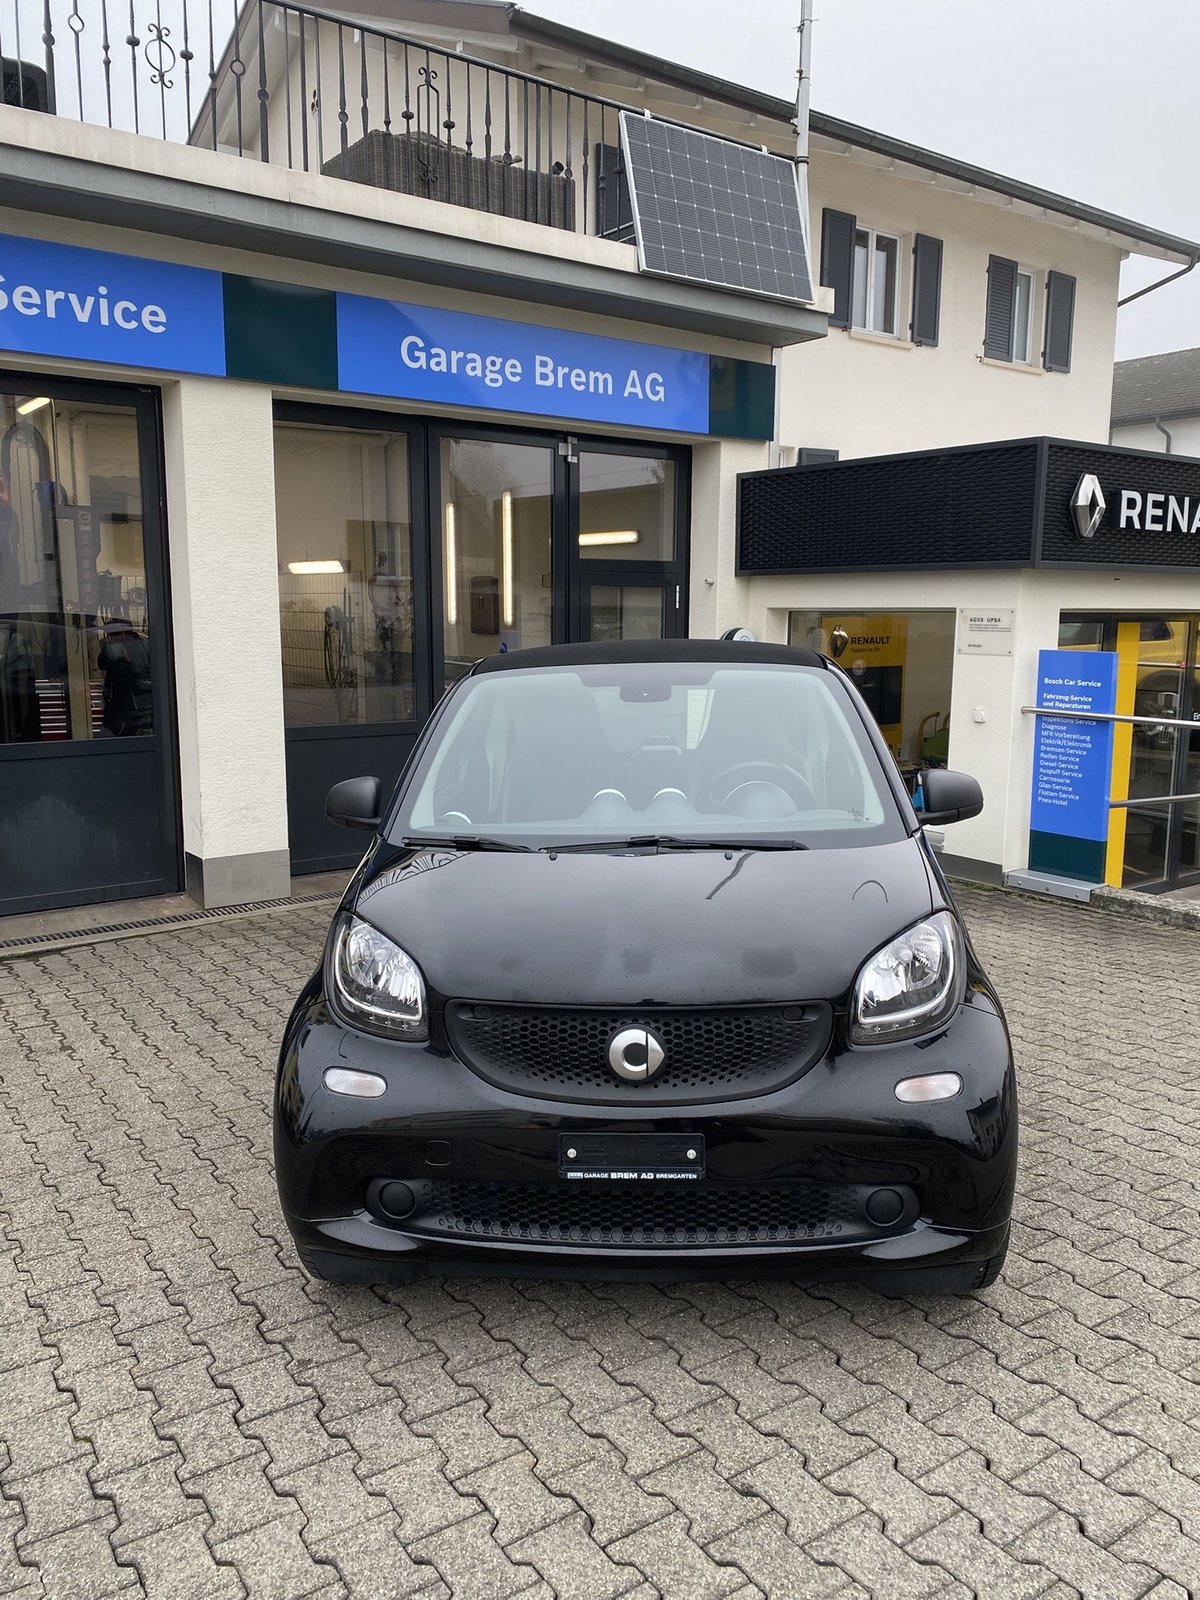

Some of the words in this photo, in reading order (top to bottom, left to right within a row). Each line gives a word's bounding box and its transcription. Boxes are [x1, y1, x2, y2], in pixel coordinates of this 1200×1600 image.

[0, 275, 167, 333] ervice
[400, 335, 522, 387] Garage
[535, 355, 613, 395] Brem
[623, 369, 665, 402] AG
[851, 636, 891, 645] RENAULT
[1044, 677, 1063, 685] Bosch
[1077, 680, 1102, 688] Service
[1043, 692, 1093, 702] Fahrzeug-Service
[1055, 701, 1091, 710] Reparaturen
[1041, 722, 1067, 730] Diagnose
[1041, 730, 1091, 742] MFK-Vorbereitung
[1041, 737, 1092, 748] Elektrik/Elektronik
[1040, 745, 1087, 755] Bremsen-Service
[1040, 752, 1080, 762] Reifen-Service
[1040, 760, 1079, 770] Diesel-Service
[1039, 767, 1082, 778] Auspuff-Service
[1039, 774, 1071, 784] Carrosserie
[1039, 781, 1072, 792] Glas-Service
[1038, 789, 1080, 800] Flotten-Service
[1038, 796, 1068, 806] Pneu-Hotel
